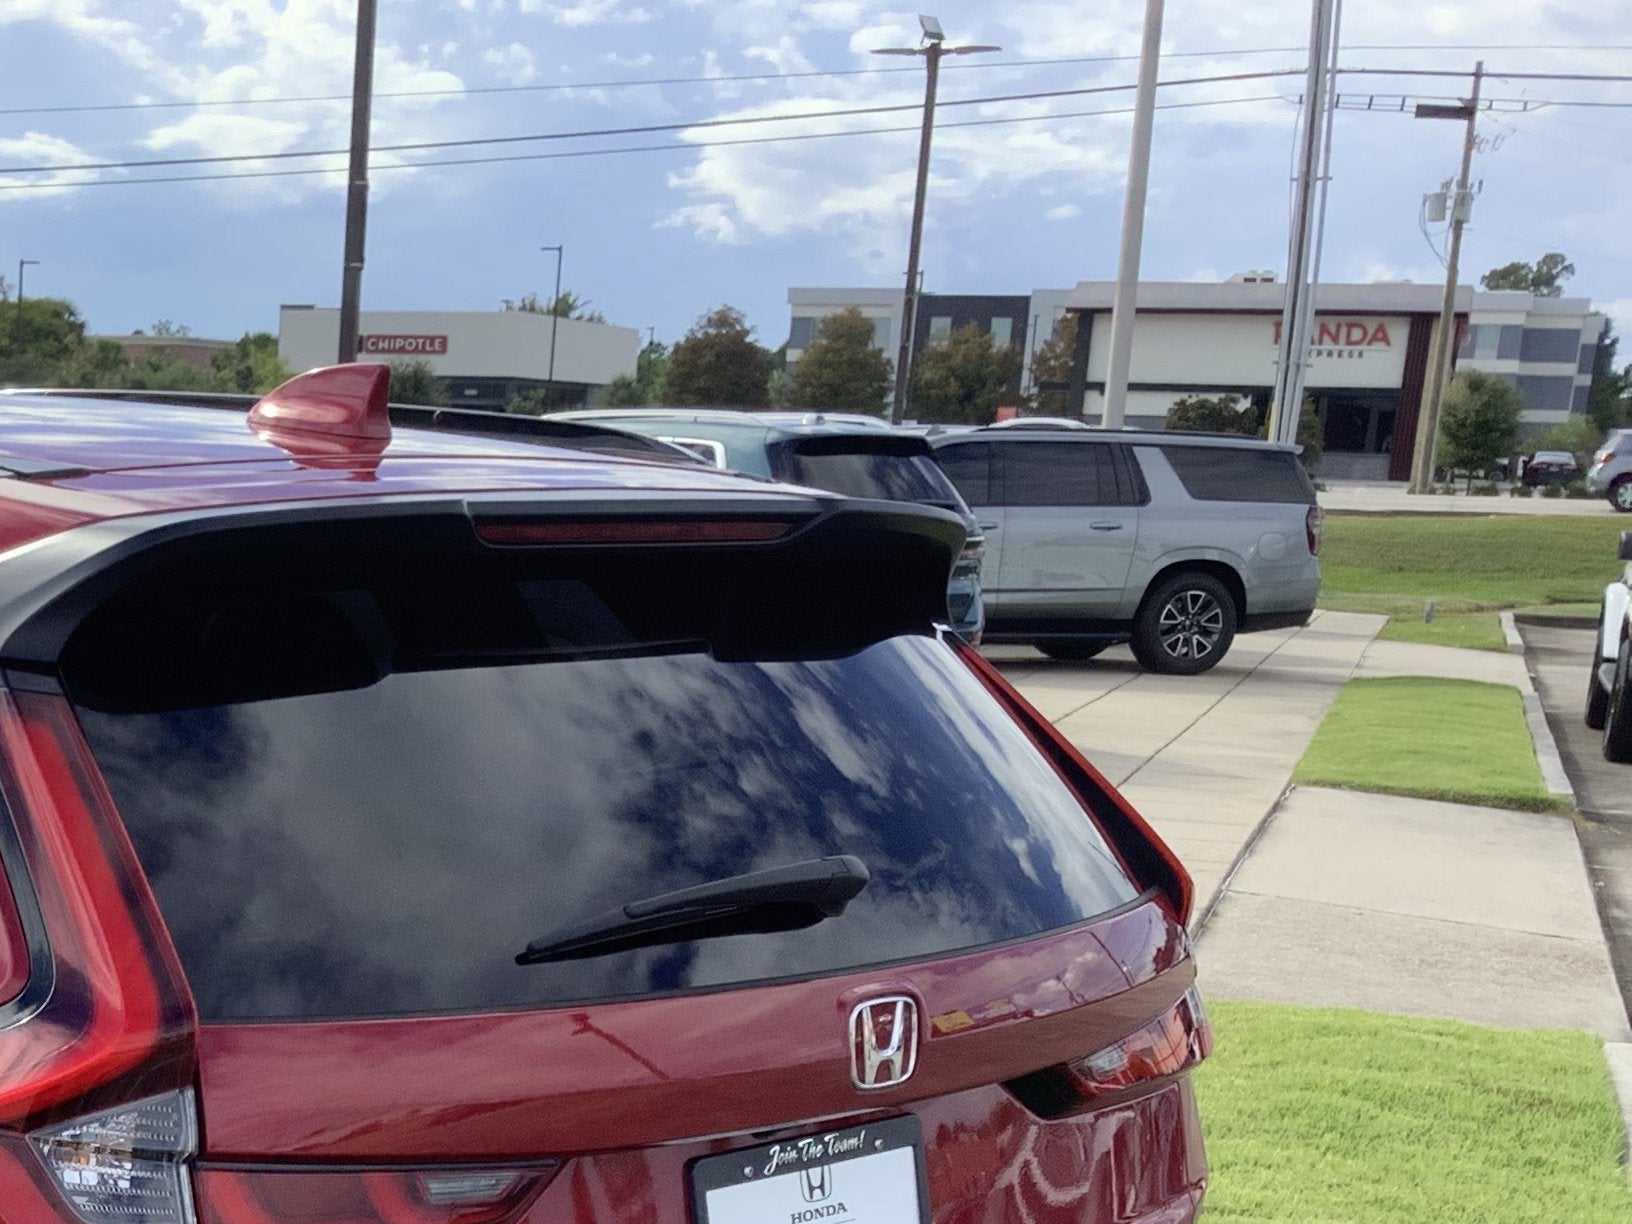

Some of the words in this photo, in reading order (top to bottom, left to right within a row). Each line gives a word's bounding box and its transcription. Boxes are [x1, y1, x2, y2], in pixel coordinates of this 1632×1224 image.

[368, 337, 444, 351] CHIPOTLE
[1273, 320, 1391, 346] NDA
[763, 1144, 798, 1176] Join
[798, 1138, 823, 1162] The
[790, 1202, 848, 1224] HONDA
